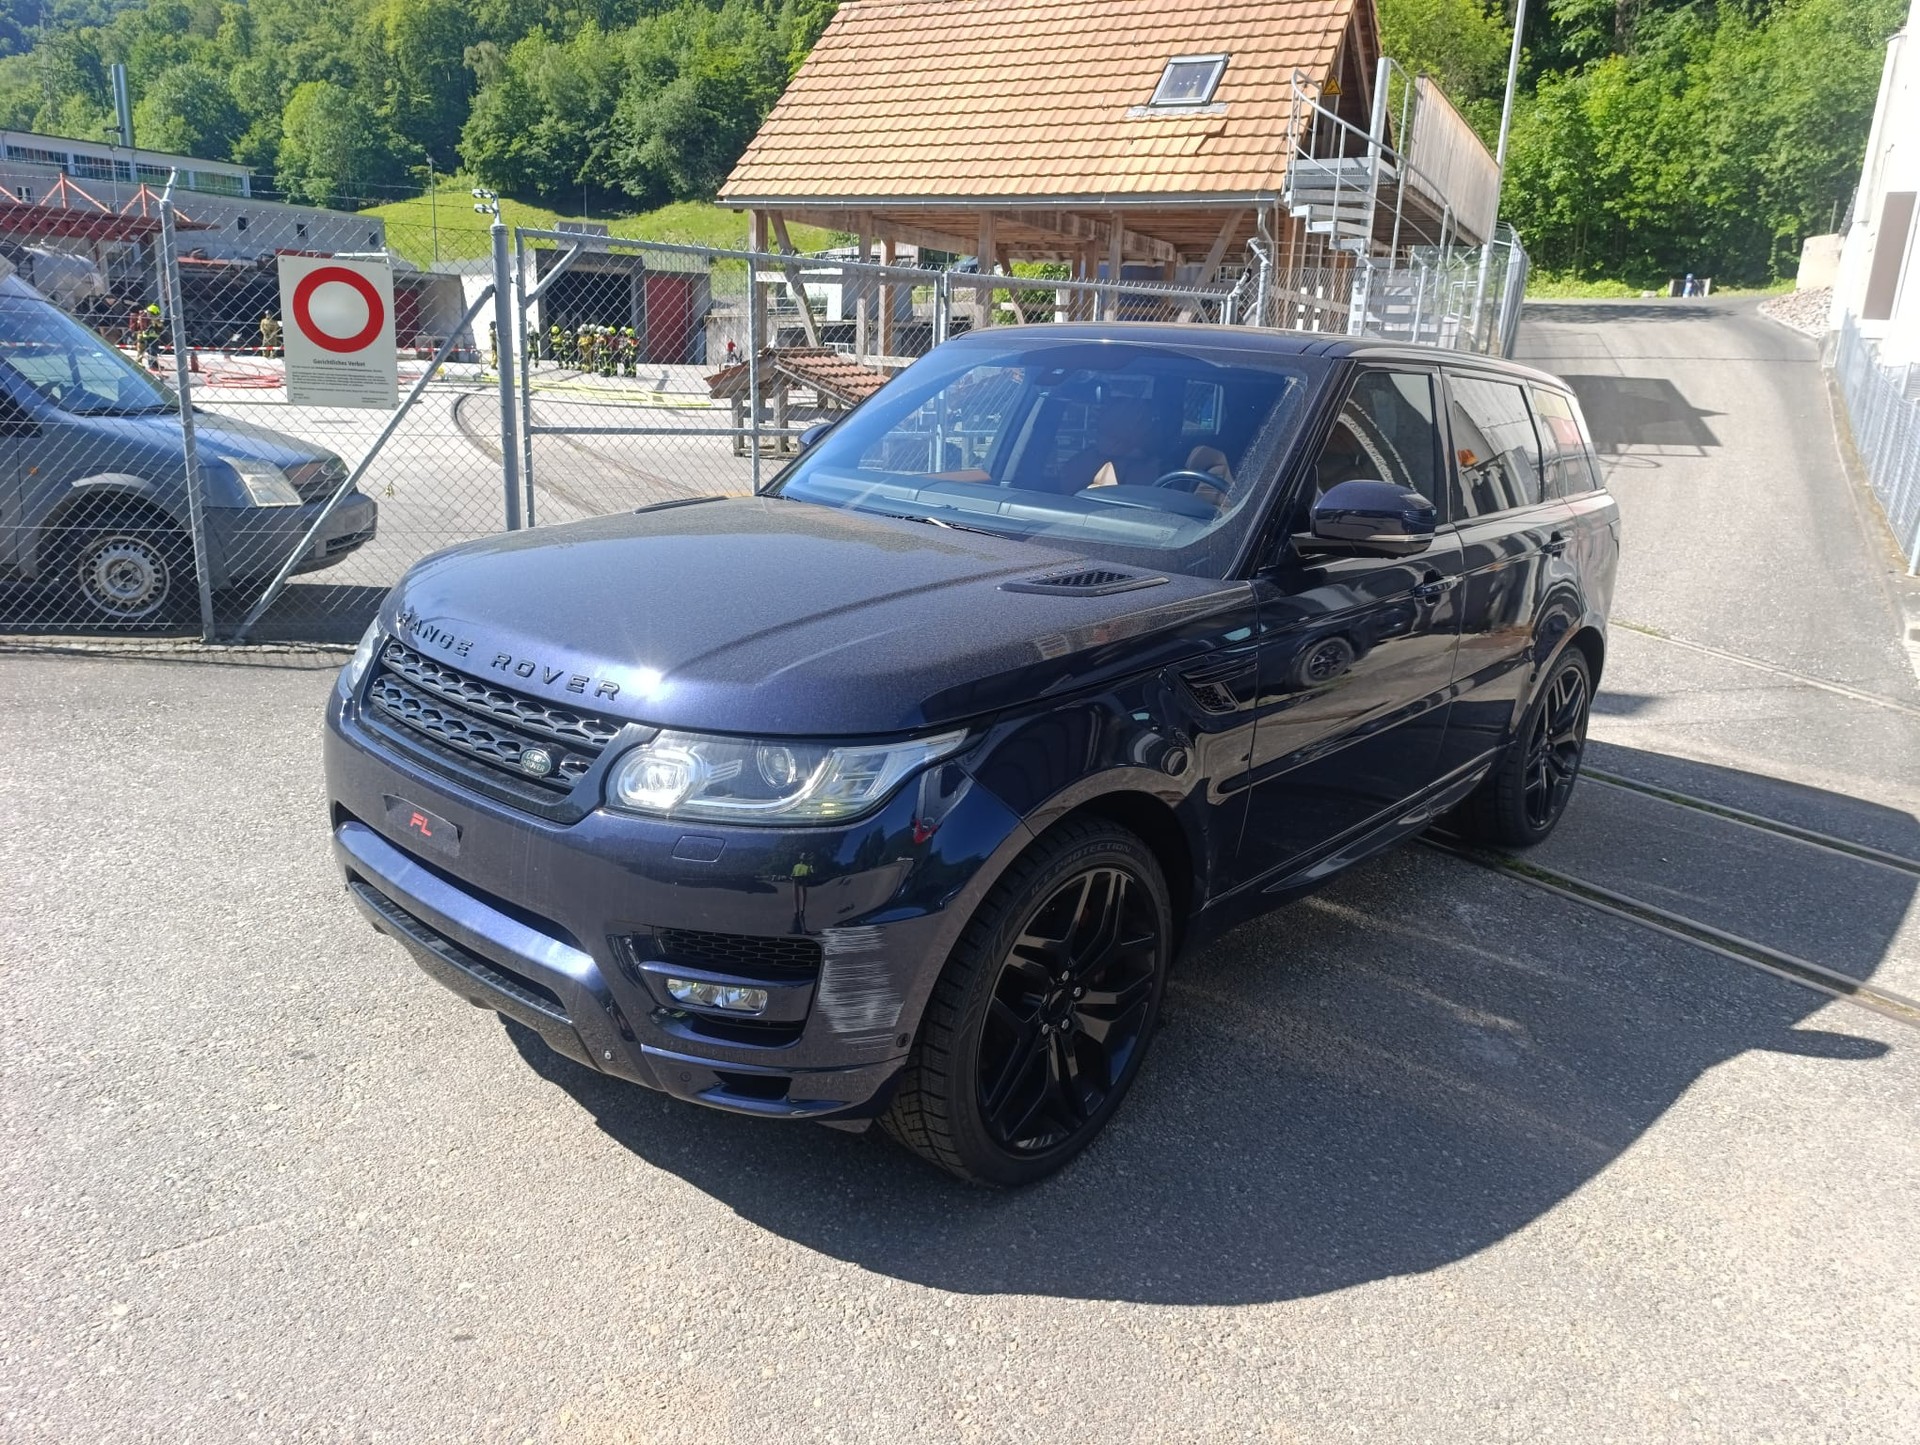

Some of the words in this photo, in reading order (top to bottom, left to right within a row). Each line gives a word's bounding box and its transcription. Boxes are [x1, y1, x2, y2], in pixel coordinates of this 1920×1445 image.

[398, 611, 474, 658] RANGE
[490, 652, 621, 702] ROVER
[526, 760, 545, 772] ROVER
[409, 811, 433, 837] FL
